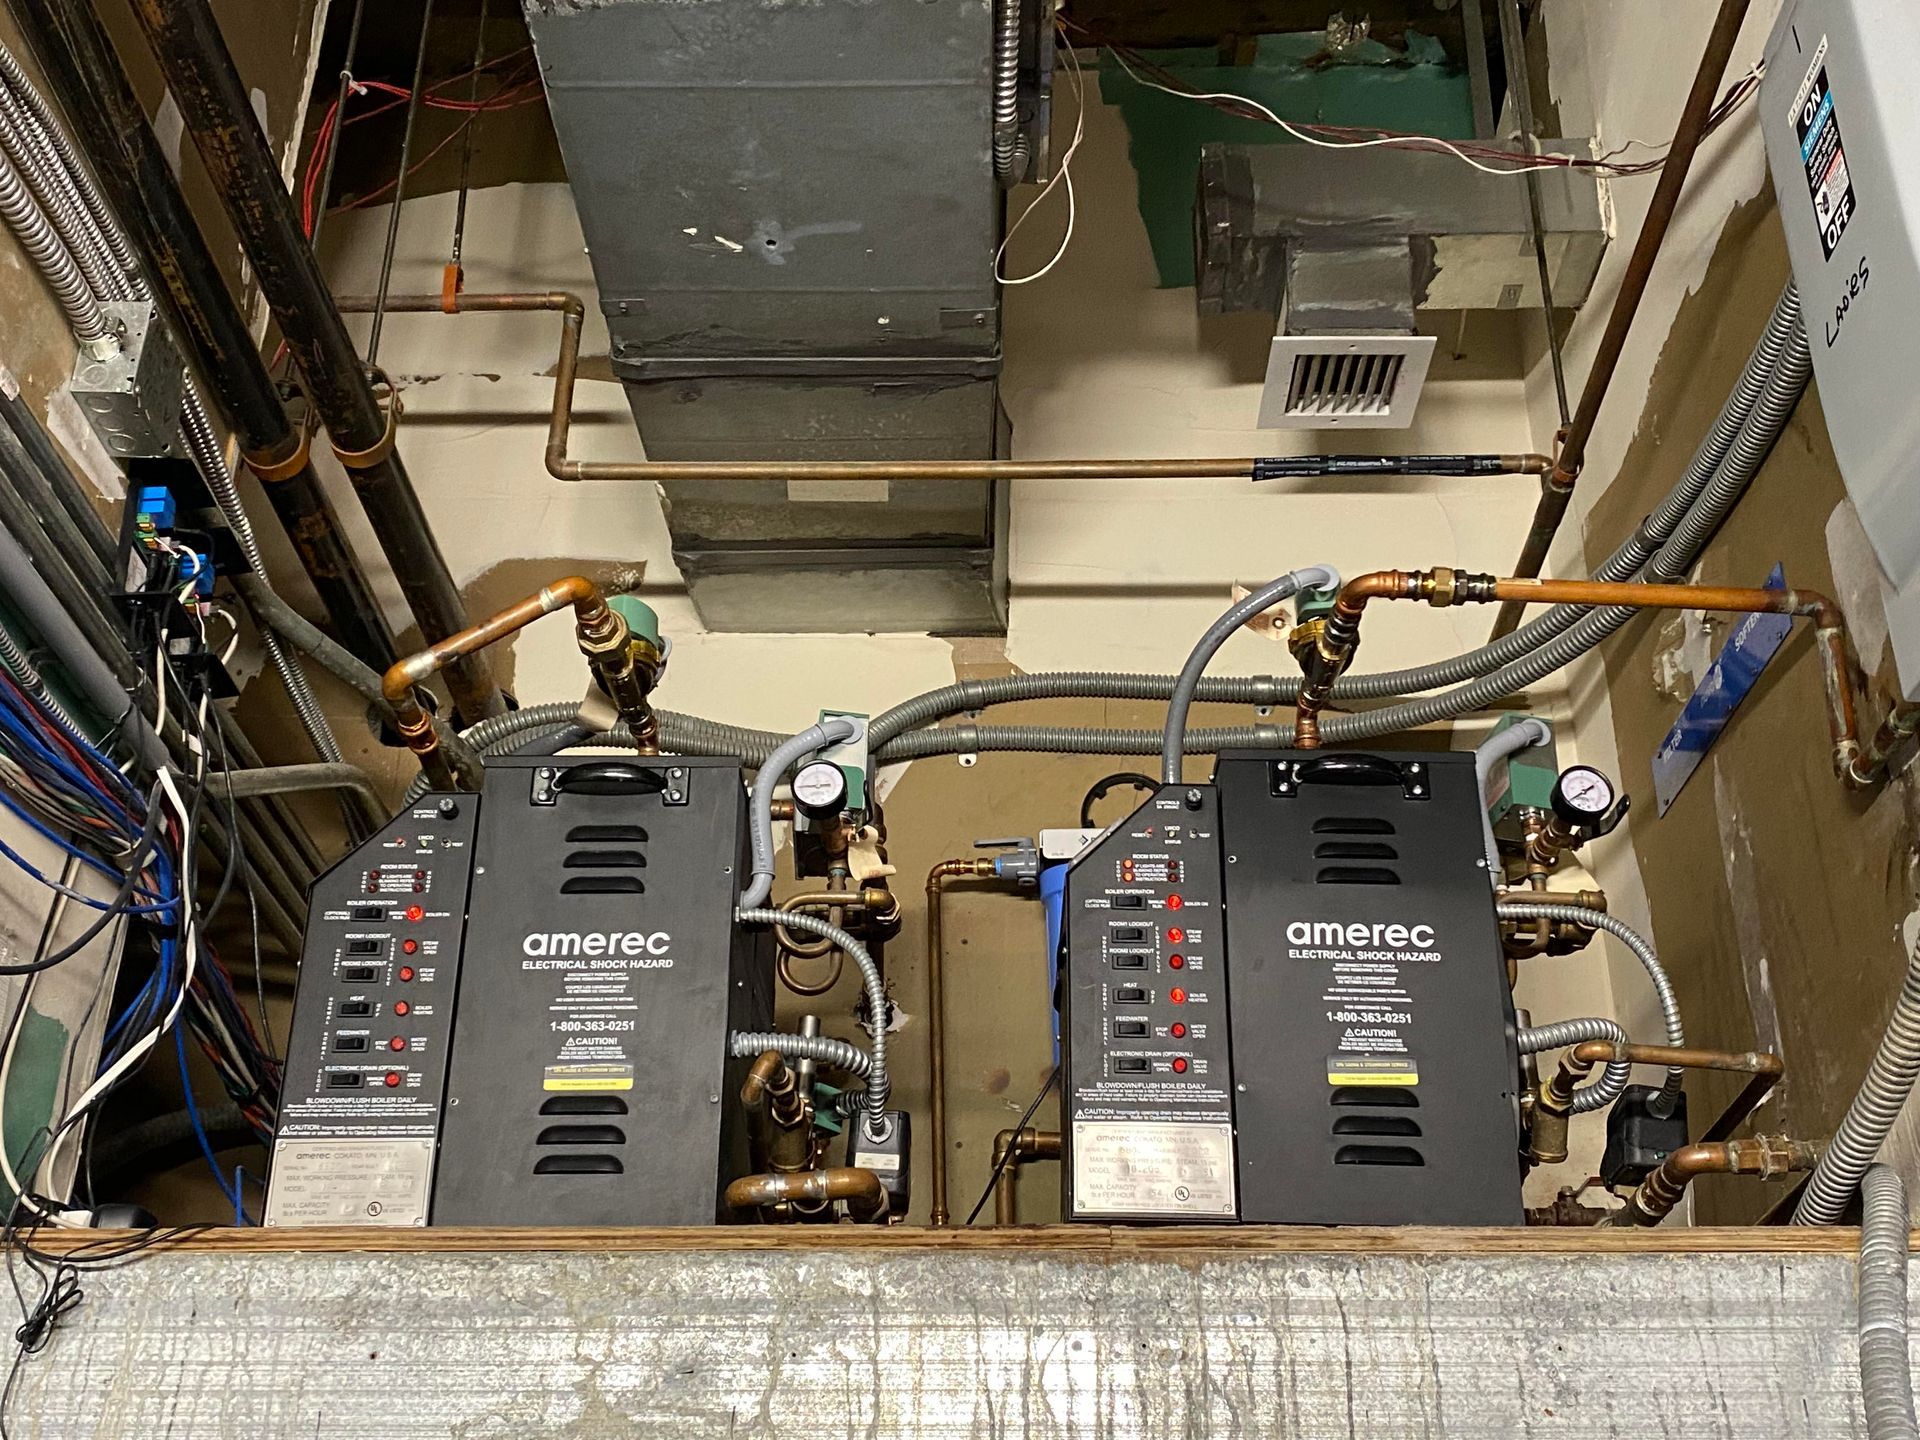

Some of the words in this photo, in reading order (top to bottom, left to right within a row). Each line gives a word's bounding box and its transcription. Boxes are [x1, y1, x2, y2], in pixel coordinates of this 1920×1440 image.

[1804, 83, 1821, 126] ON
[1805, 98, 1830, 155] SIEMENS
[1827, 194, 1849, 249] OFF
[1735, 612, 1763, 653] SOFTEN
[1286, 921, 1435, 948] amerec
[523, 932, 670, 956] amerec
[522, 961, 588, 969] ELECTRICAL
[590, 960, 628, 969] SHOCK
[630, 959, 673, 968] HAZARD
[1289, 949, 1355, 960] ELECTRICAL
[1357, 951, 1395, 960] SHOCK
[1397, 952, 1442, 962] HAZARD
[550, 1021, 635, 1032] 1-800-363-0251
[1326, 1011, 1412, 1024] 1-800-363-0251
[576, 1037, 618, 1045] CAUTION!
[1356, 1029, 1397, 1037] CAUTION!
